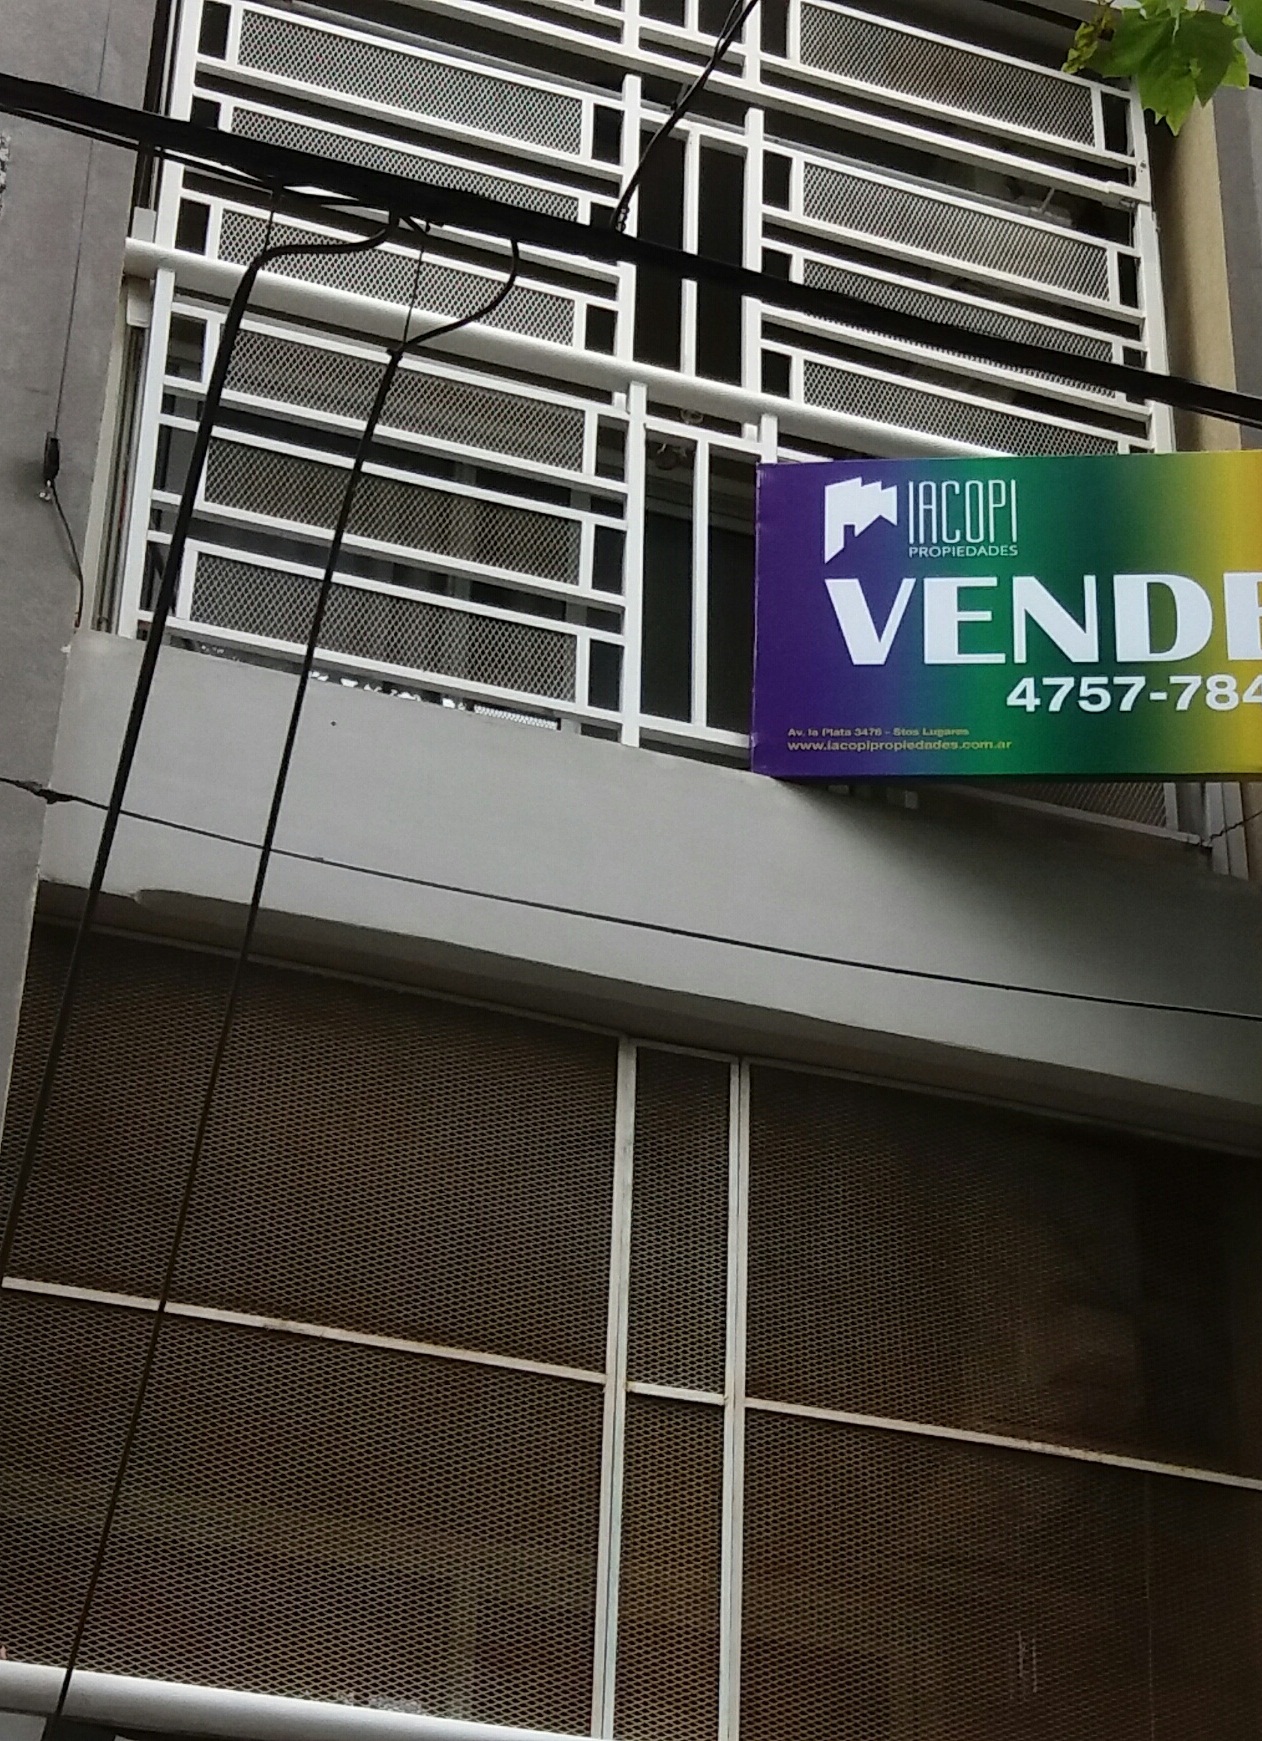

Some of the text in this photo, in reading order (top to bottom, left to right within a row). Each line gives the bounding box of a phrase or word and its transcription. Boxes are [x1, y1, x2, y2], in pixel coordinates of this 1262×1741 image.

[908, 479, 1018, 544] IACOPI
[908, 544, 1018, 558] PROPIEDADES
[788, 728, 805, 737] Av.
[822, 728, 852, 737] Plata
[893, 728, 919, 737] Stos
[923, 728, 970, 738] Lugares
[787, 739, 1012, 752] www.iacopipropiedades.com.ar
